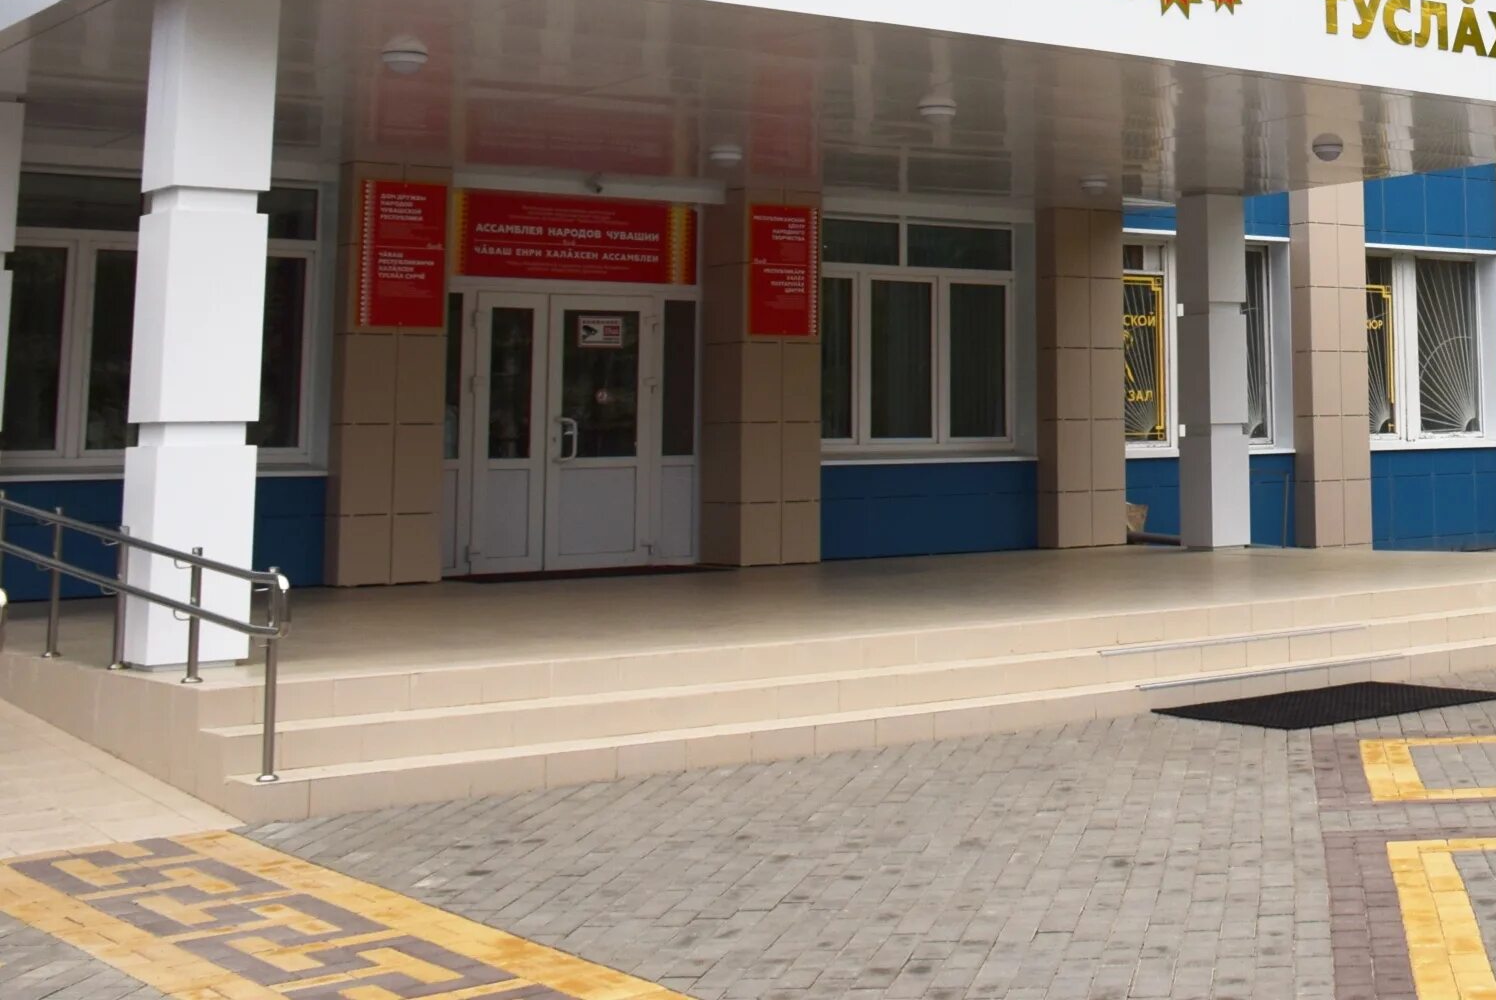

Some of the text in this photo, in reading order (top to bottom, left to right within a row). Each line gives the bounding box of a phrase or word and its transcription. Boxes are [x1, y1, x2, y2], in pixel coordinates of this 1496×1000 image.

[475, 223, 660, 242] АССАМБЛЕЯ НАРОДОВ ЧУВАШИИ
[1128, 390, 1153, 402] ЗАЛ
